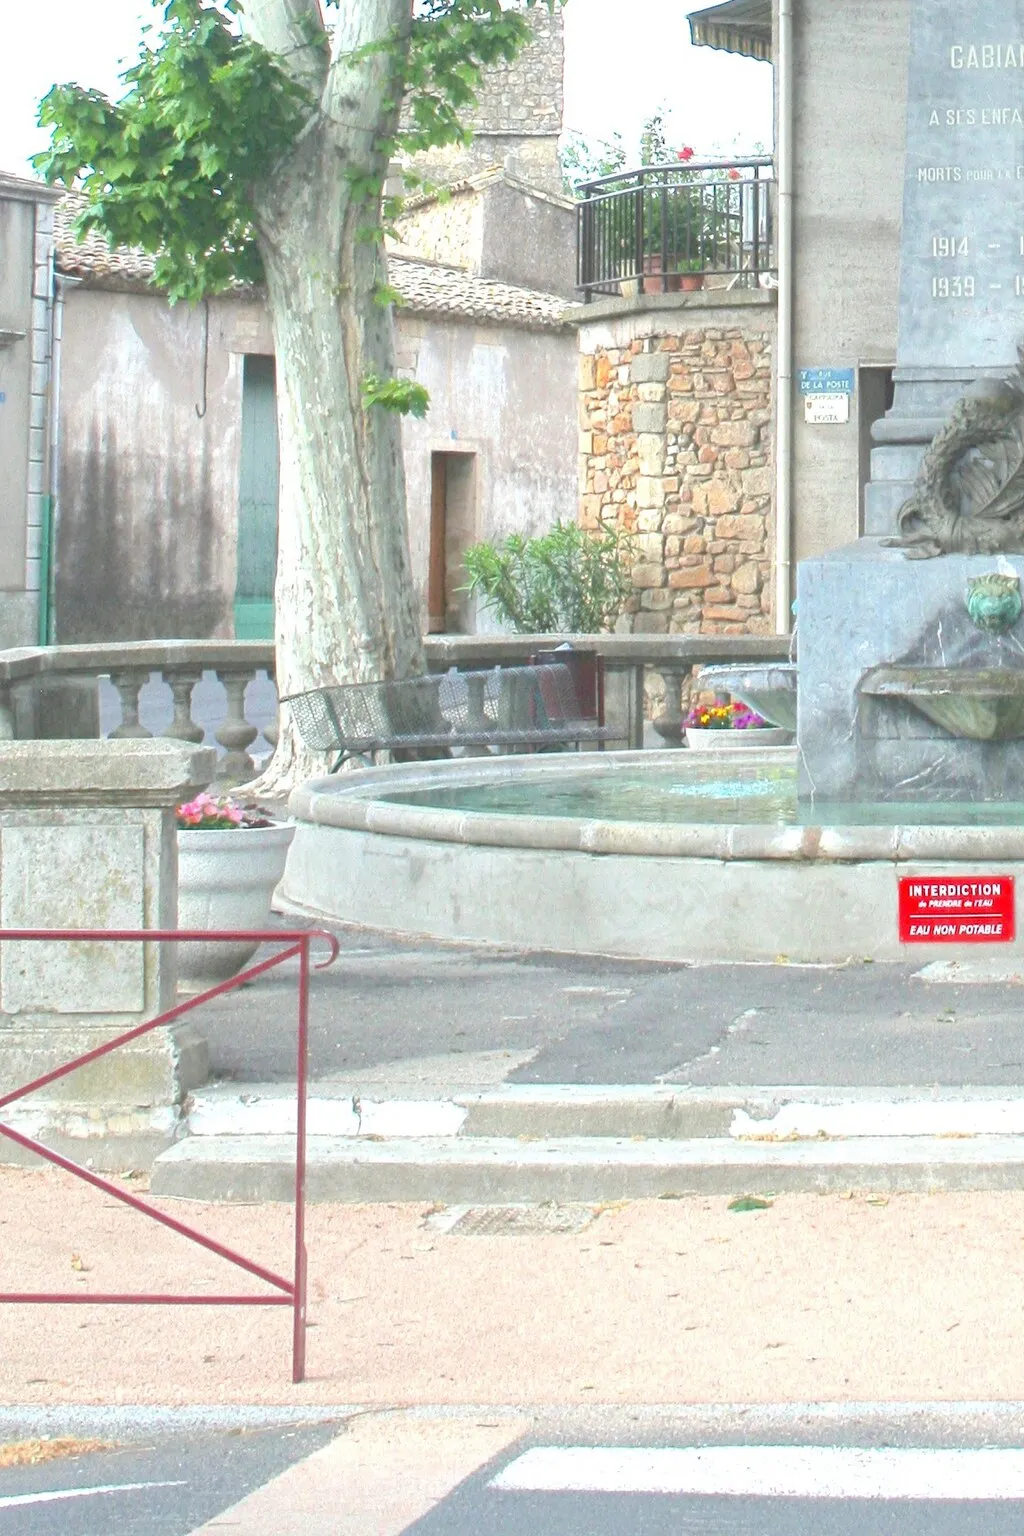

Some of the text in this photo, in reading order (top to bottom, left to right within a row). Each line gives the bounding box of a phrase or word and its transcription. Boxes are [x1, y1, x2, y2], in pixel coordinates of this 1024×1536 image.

[929, 110, 940, 126] A
[946, 109, 976, 126] SES
[918, 167, 962, 182] MORTS
[932, 236, 970, 257] 1914
[932, 276, 975, 298] 1939
[801, 380, 849, 389] DE LA POSTE
[909, 884, 1001, 897] INTERDICTION
[909, 924, 1003, 936] EAU NON POTABLE
